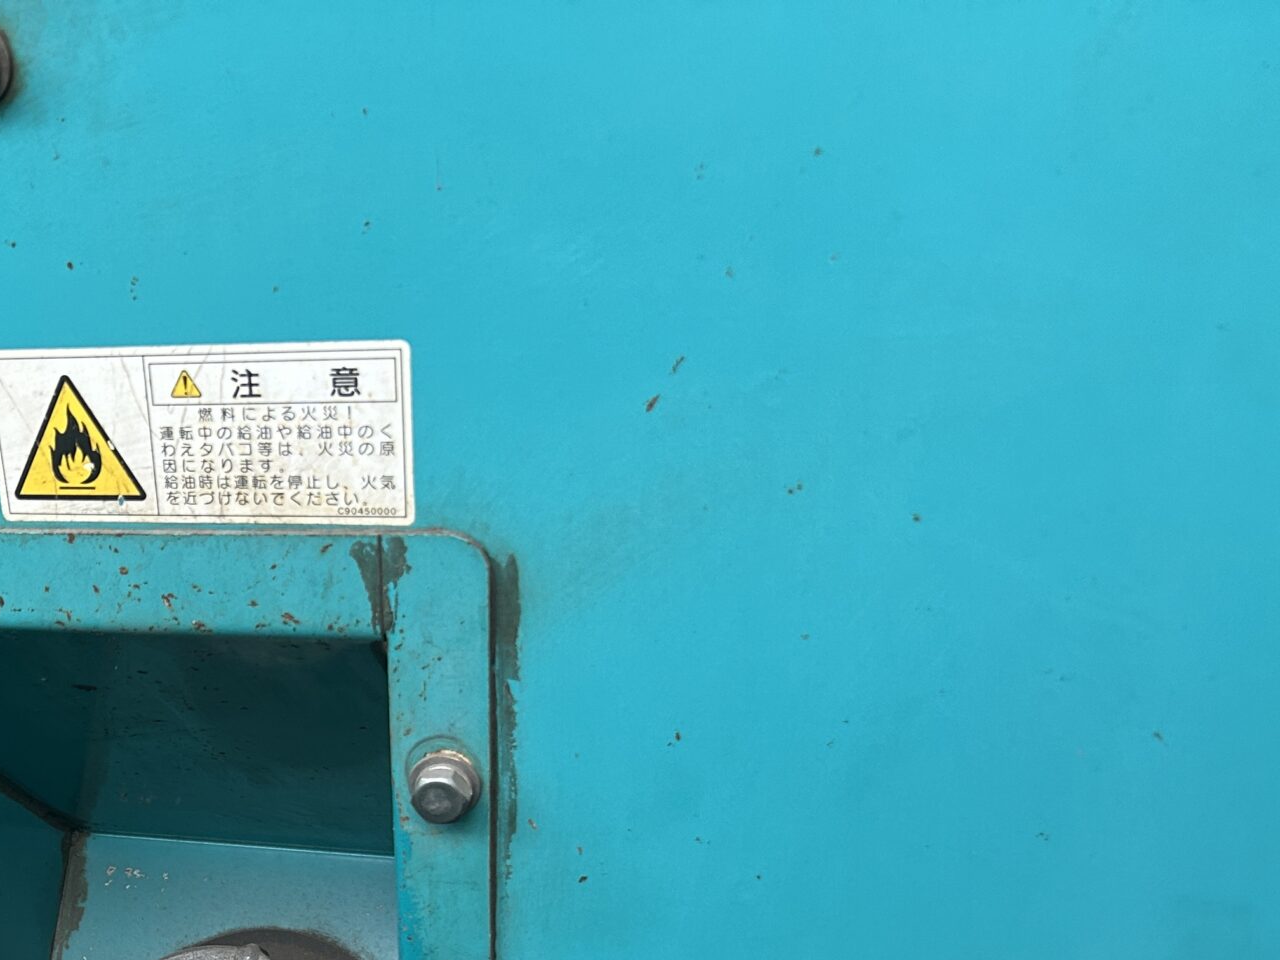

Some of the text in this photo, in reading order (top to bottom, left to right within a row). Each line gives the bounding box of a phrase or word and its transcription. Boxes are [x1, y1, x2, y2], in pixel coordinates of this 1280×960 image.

[160, 425, 393, 441] 運転中の給油や給油中のく
[161, 442, 395, 457] わえタバコ等は、火災の原
[163, 459, 285, 473] 因になります。
[165, 475, 396, 490] 給油時は運転を停止し、火気
[166, 492, 368, 506] を近づけないでください。
[337, 508, 396, 516] C90450000
